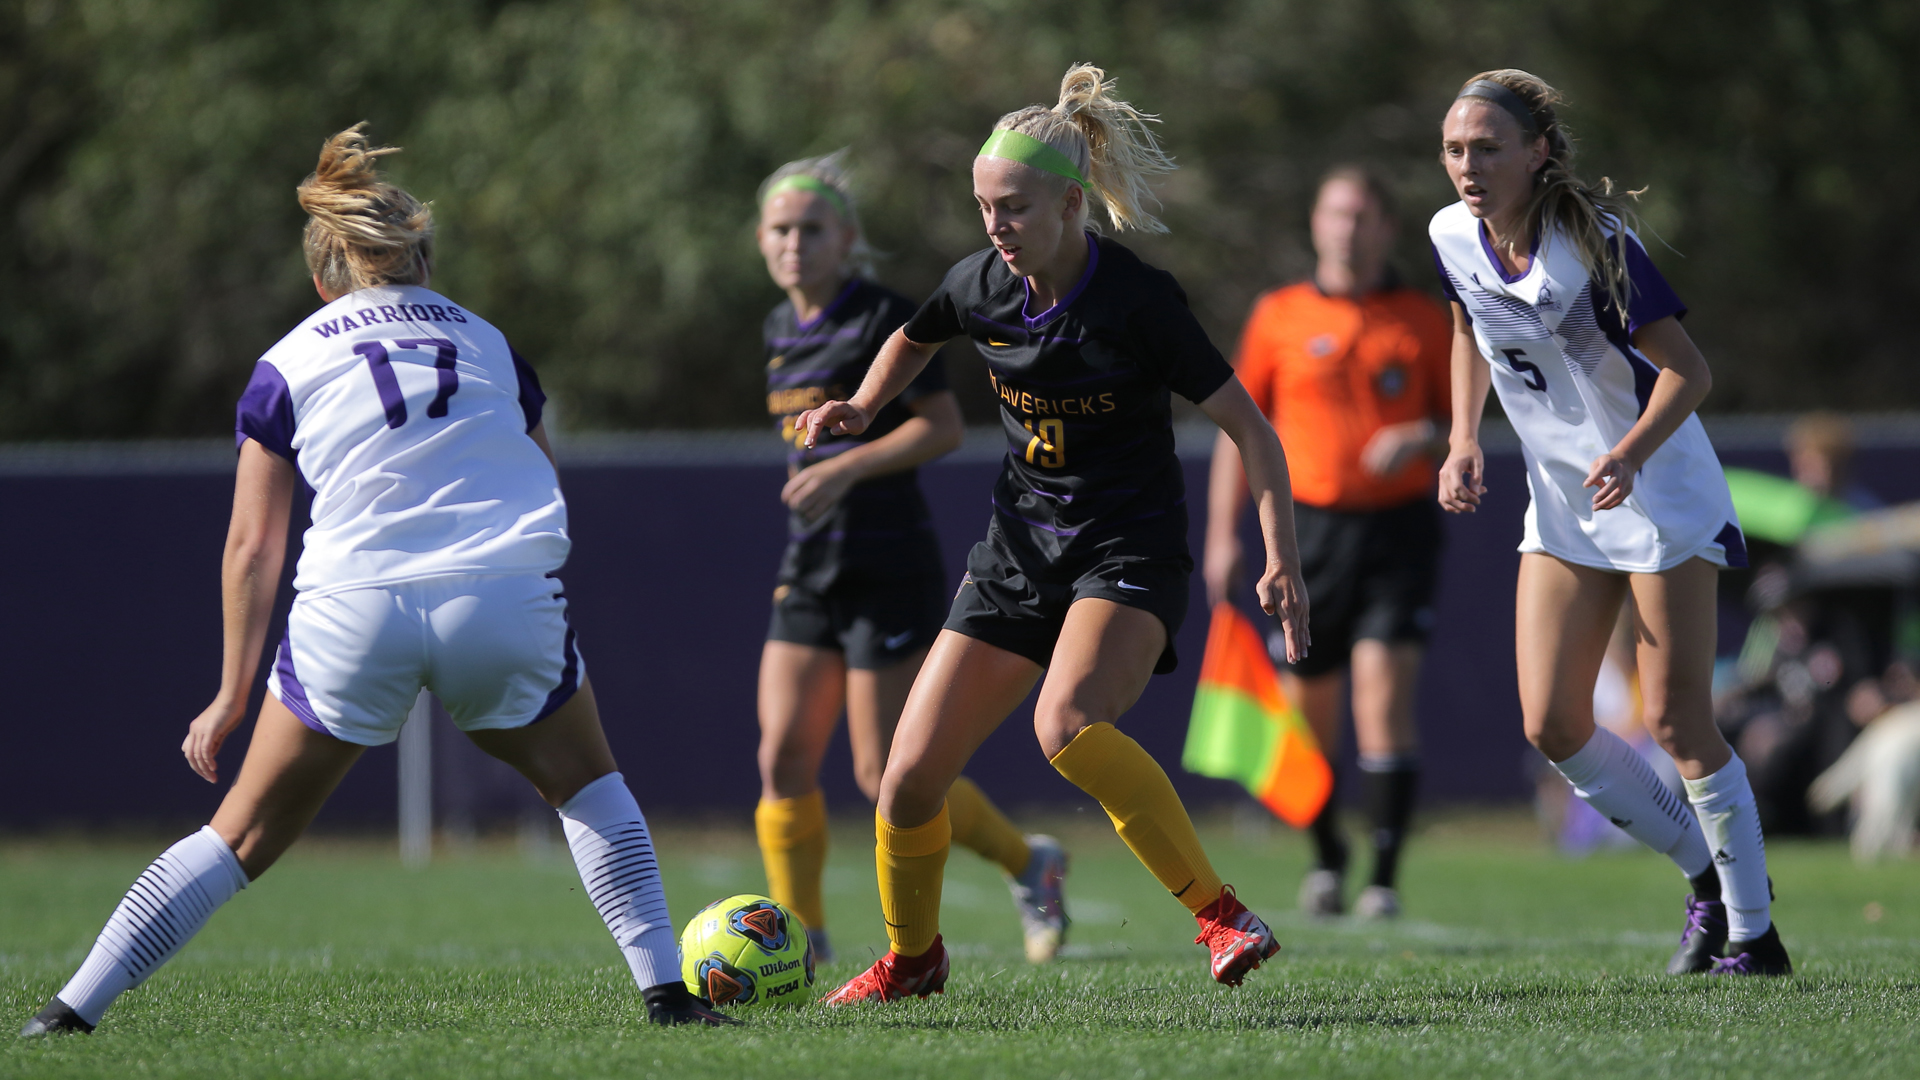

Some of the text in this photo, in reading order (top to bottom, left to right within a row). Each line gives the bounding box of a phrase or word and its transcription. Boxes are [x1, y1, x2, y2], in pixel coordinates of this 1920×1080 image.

[312, 303, 468, 338] WARRIORS
[352, 337, 459, 430] 17
[1500, 348, 1548, 392] 5
[1024, 418, 1066, 468] 19
[759, 959, 801, 977] Wilson
[765, 979, 799, 999] NCAA
